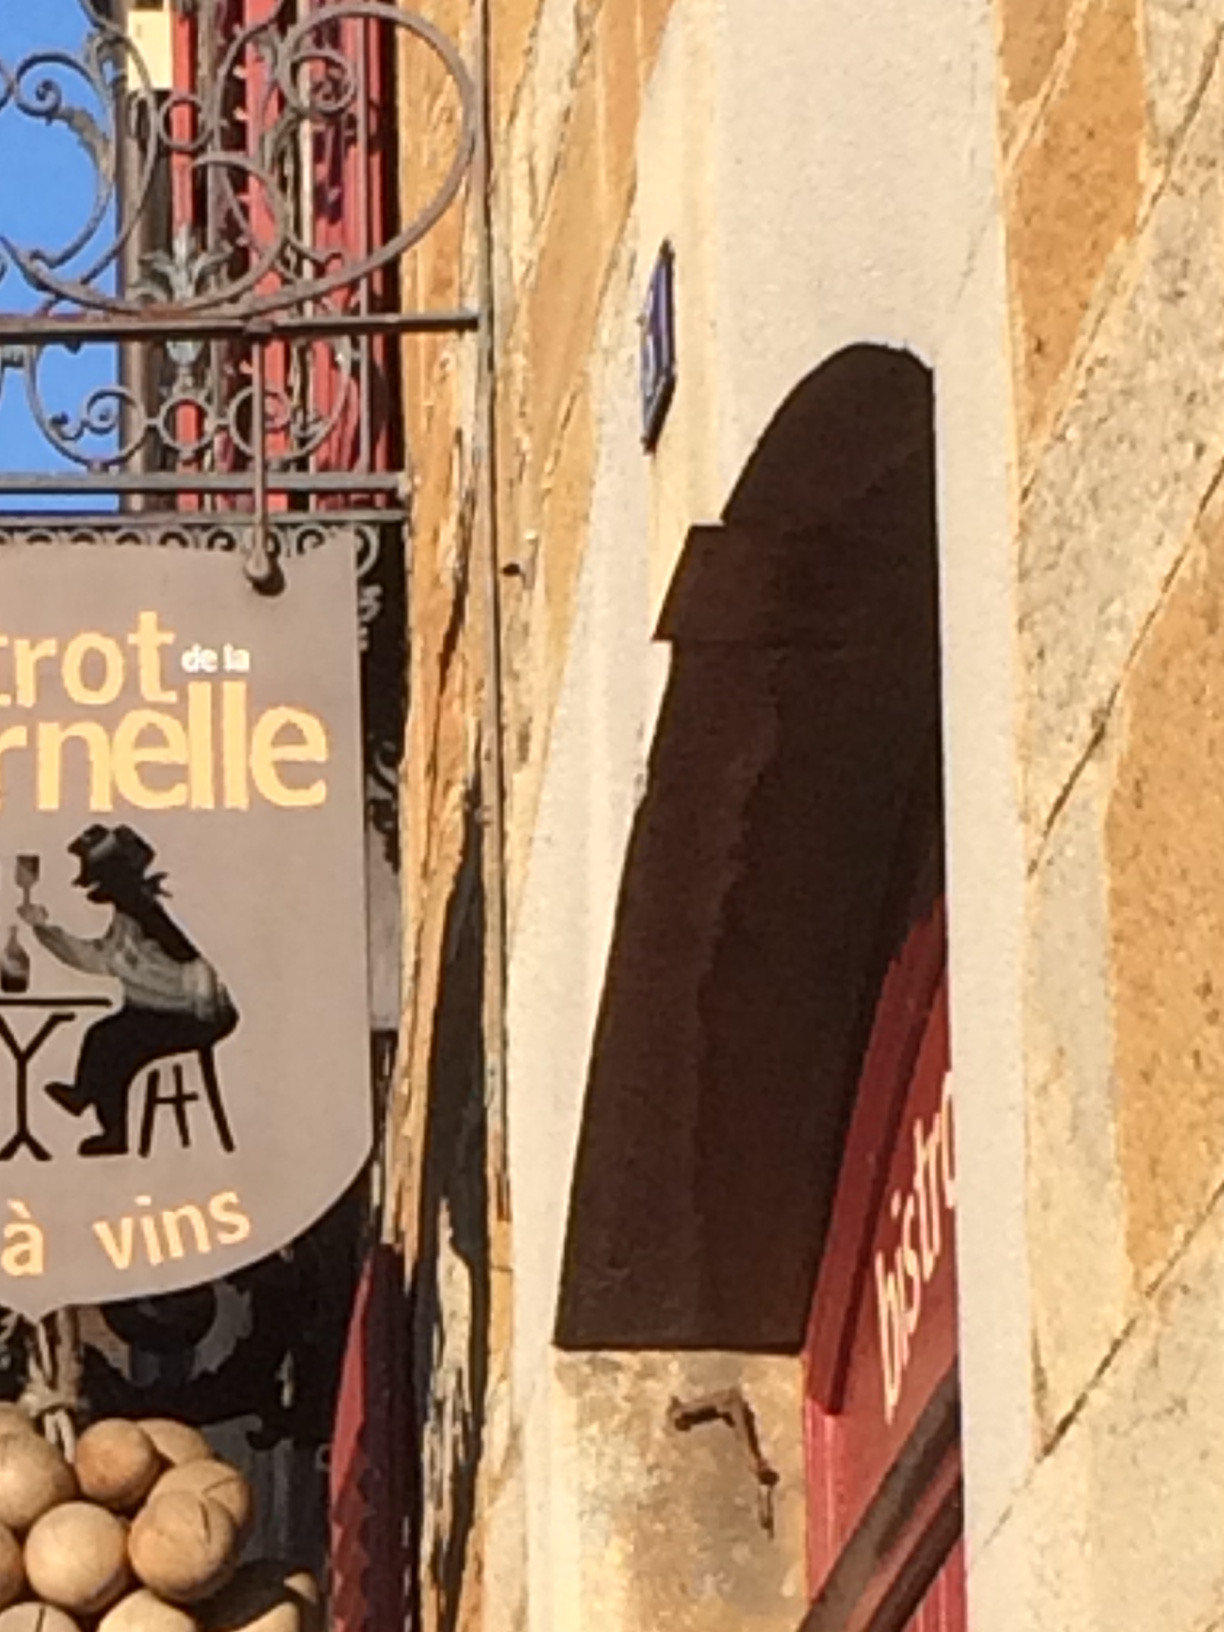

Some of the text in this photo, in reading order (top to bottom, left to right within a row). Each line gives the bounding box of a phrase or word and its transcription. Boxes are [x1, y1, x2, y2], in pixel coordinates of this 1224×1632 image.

[180, 642, 218, 673] de
[223, 642, 251, 673] la
[0, 1200, 44, 1276] à
[94, 1188, 251, 1270] vins
